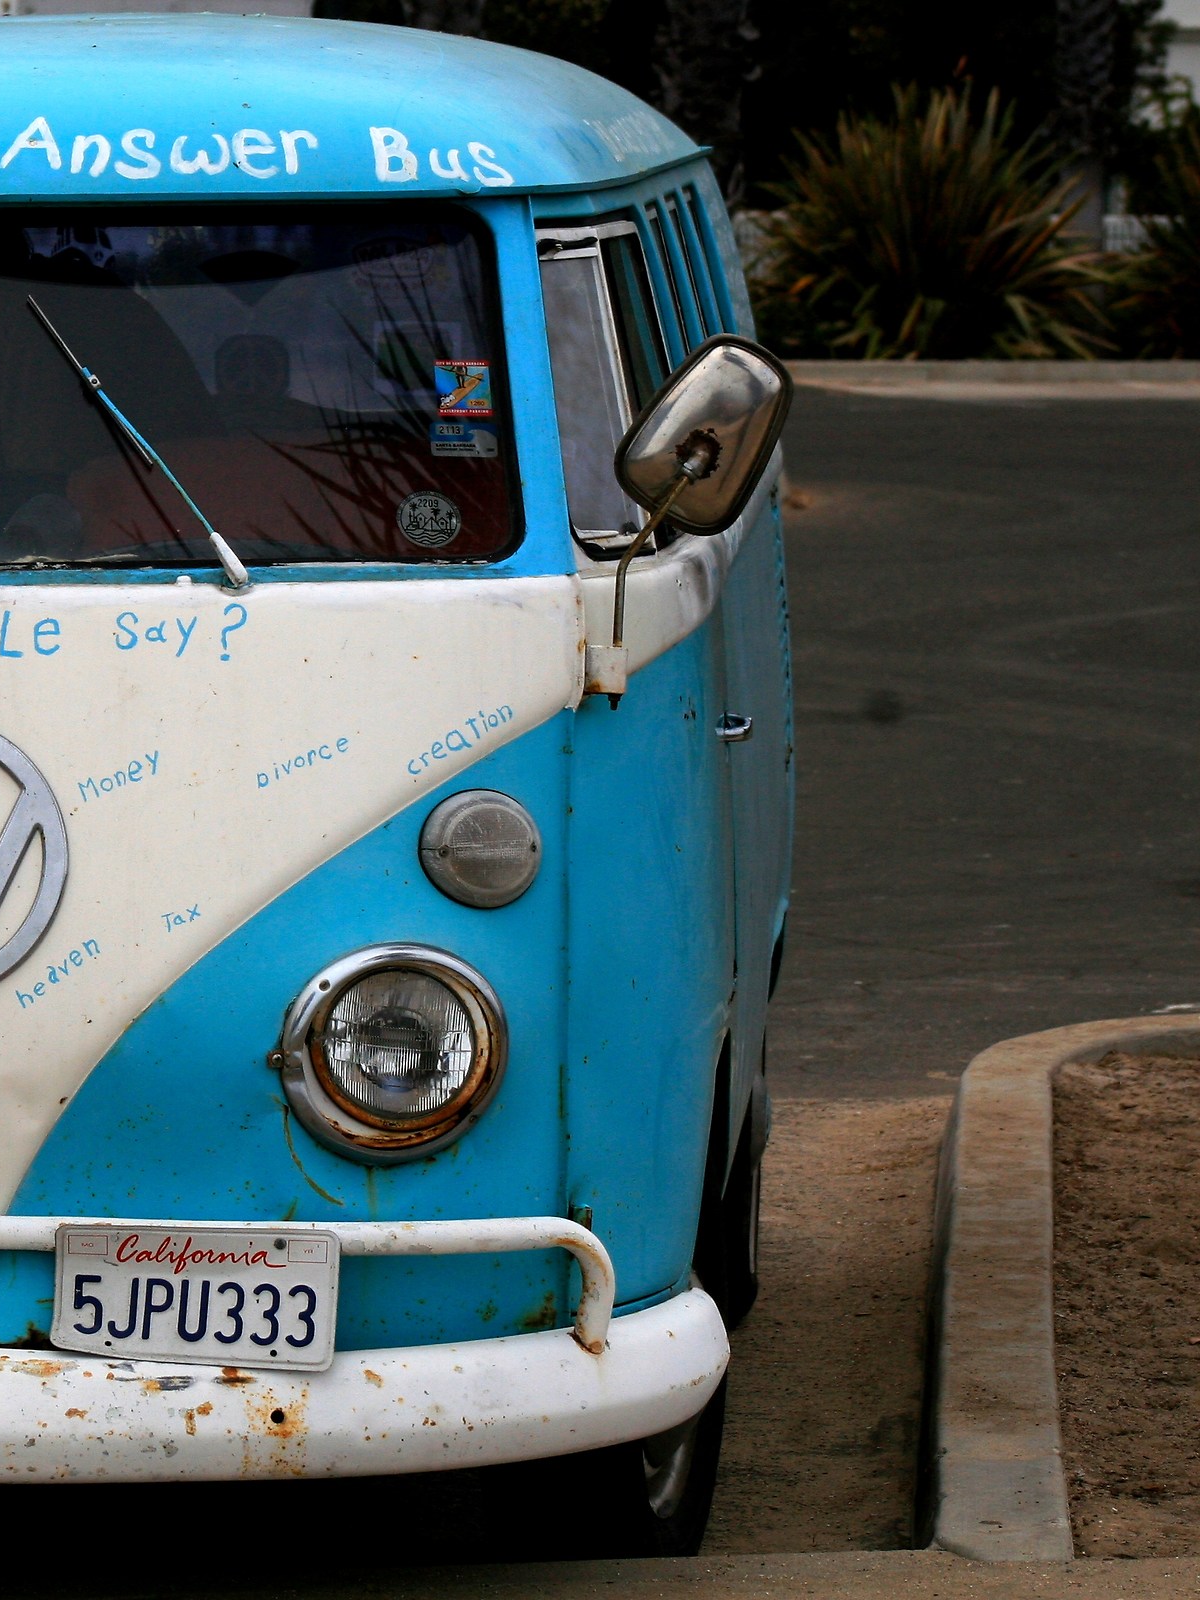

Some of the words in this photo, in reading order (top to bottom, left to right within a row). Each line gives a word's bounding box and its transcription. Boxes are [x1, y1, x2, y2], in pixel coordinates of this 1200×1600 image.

[0, 116, 318, 180] Answer
[369, 126, 515, 187] Bus
[439, 425, 461, 434] 2113
[418, 498, 439, 508] 2209
[115, 611, 198, 657] Say
[406, 704, 514, 776] creation
[77, 750, 160, 803] Money
[161, 904, 201, 933] Tax
[15, 938, 101, 1009] heaven
[115, 1234, 288, 1275] California
[73, 1273, 318, 1349] 5JPU333
